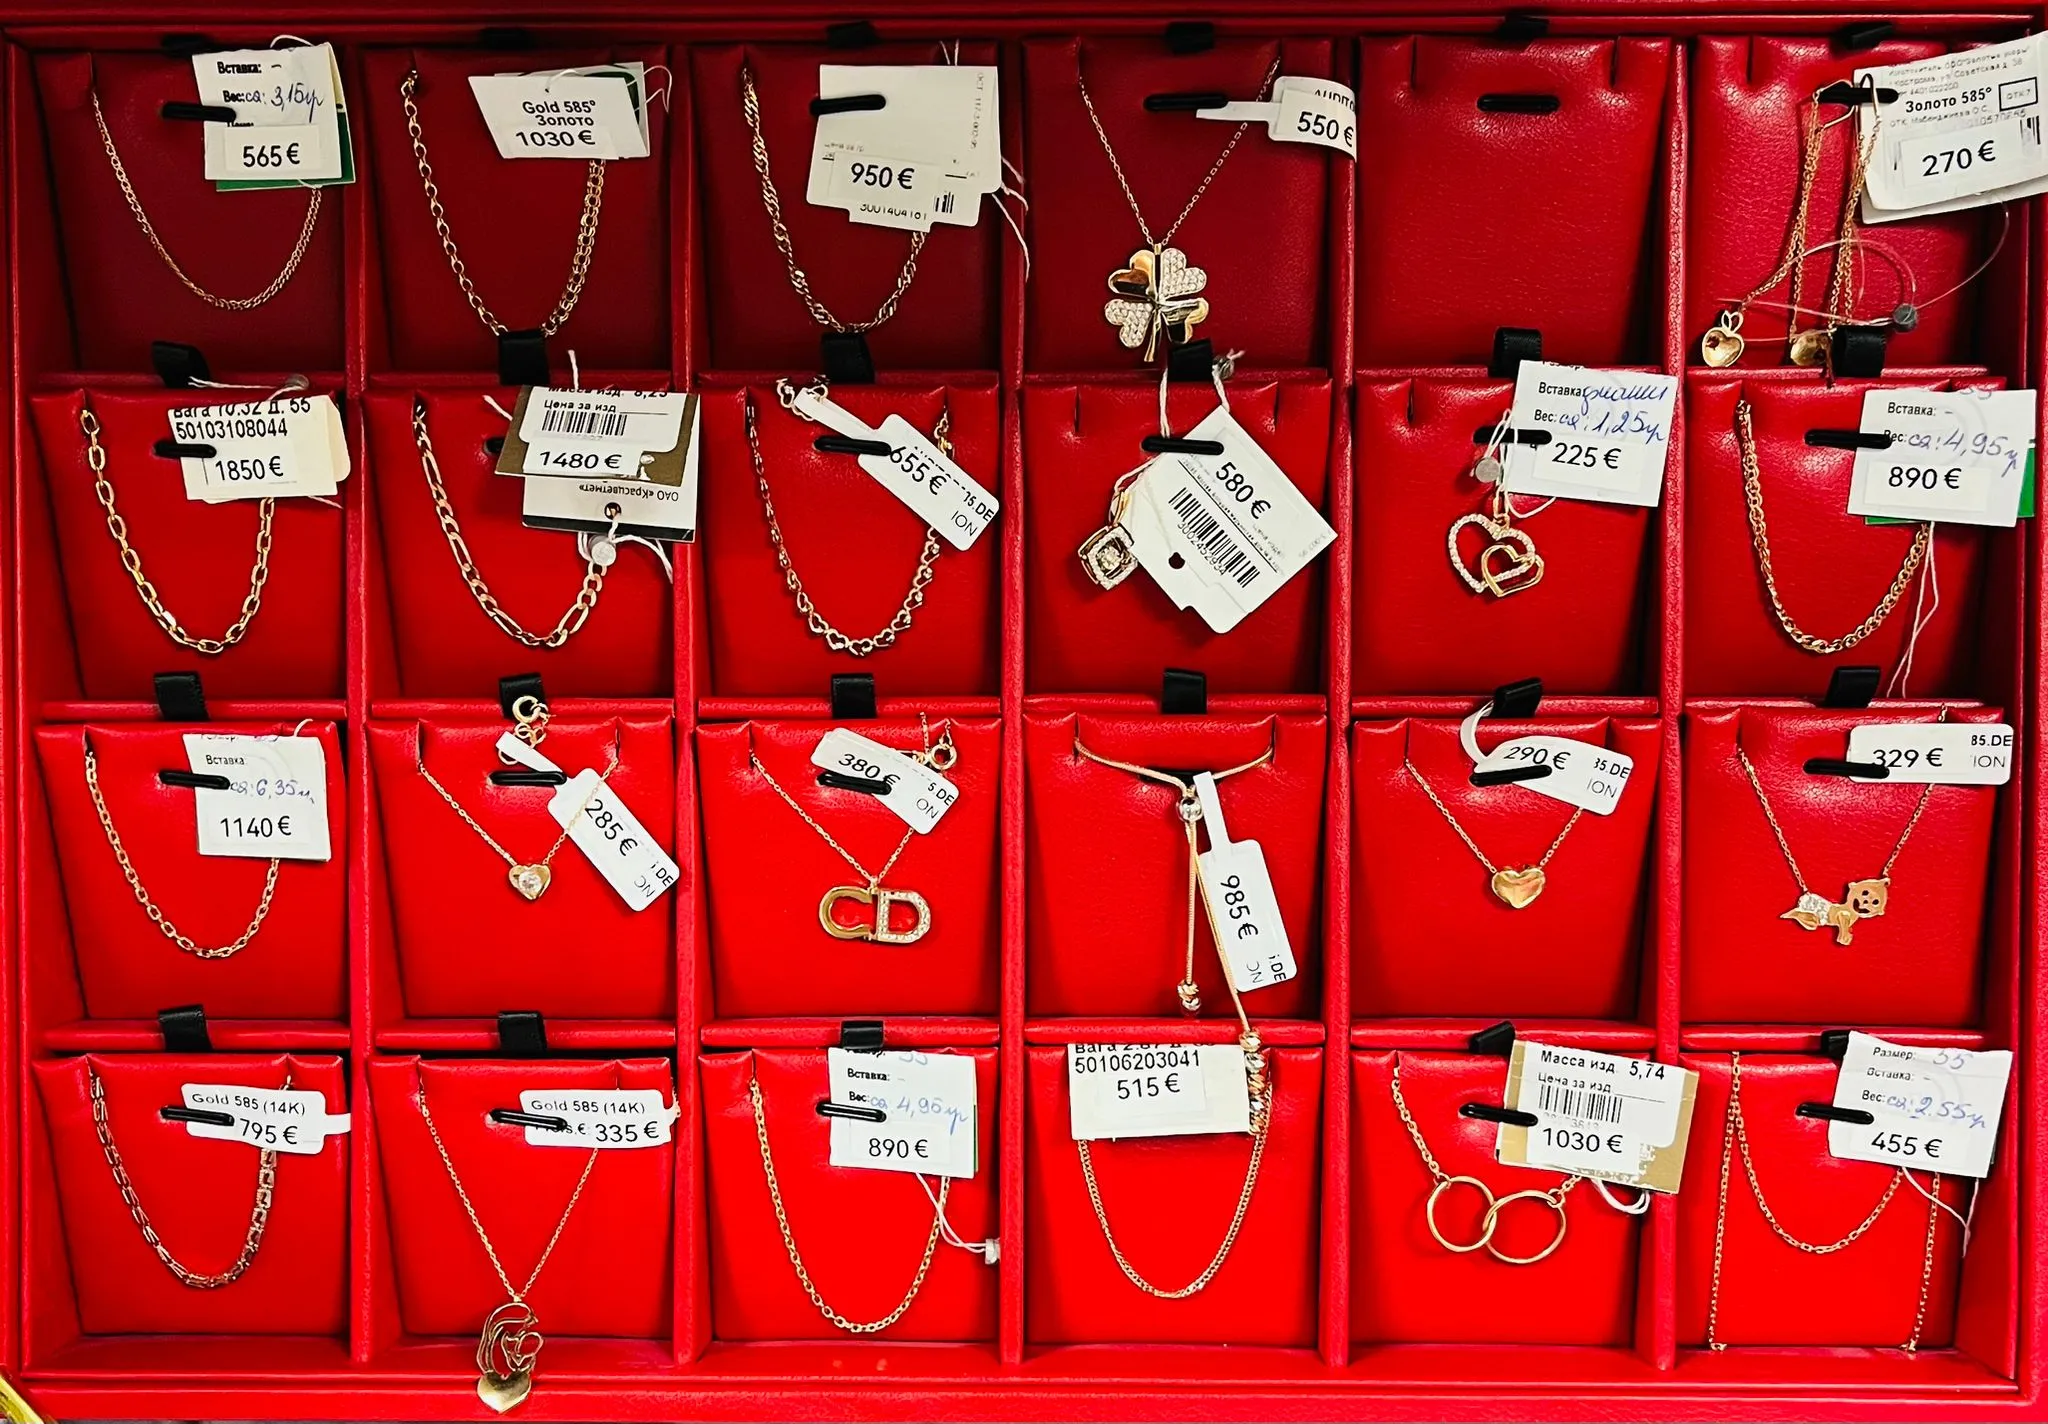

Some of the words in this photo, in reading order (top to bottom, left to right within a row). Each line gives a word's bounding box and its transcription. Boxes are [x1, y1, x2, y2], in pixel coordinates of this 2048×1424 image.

[217, 61, 262, 74] Вставка:
[522, 101, 561, 115] Gold
[1905, 96, 1957, 113] Золото
[535, 115, 595, 126] Золото
[290, 397, 311, 413] 55
[543, 399, 575, 410] Цена
[1887, 401, 1937, 416] Вставка:
[1534, 409, 1558, 423] Вес:
[175, 417, 288, 440] 50103108044
[656, 491, 680, 502] ОАО
[1872, 1046, 1916, 1060] Размер:
[1074, 1049, 1200, 1074] 50106203041
[1540, 1050, 1585, 1068] Масса
[1629, 1060, 1666, 1081] 5,74
[847, 1067, 891, 1082] Вставка:
[1861, 1089, 1886, 1103] Вес:
[191, 1093, 230, 1106] Gold
[234, 1095, 260, 1111] 585
[263, 1099, 306, 1117] (14K)
[531, 1099, 568, 1111] Gold
[573, 1100, 600, 1113] 585
[603, 1101, 646, 1116] (14K)
